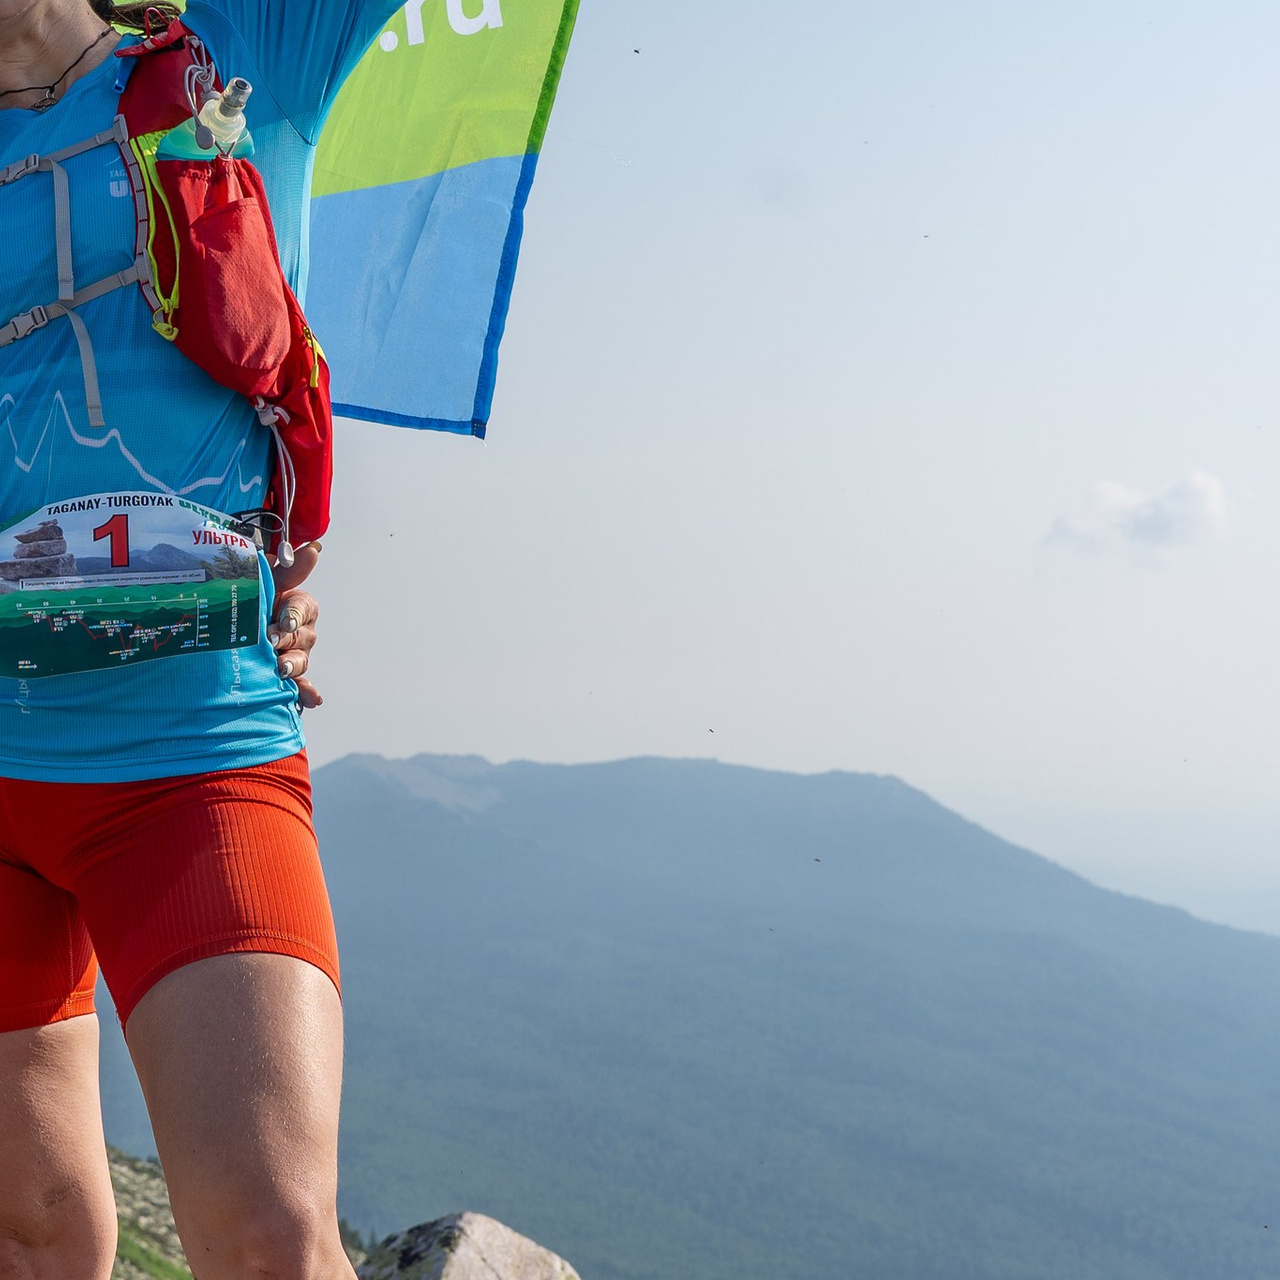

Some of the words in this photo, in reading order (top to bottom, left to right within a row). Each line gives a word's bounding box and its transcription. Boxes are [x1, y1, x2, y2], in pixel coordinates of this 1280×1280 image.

[46, 496, 173, 516] TAGANAY-TURGOYAK
[93, 513, 130, 568] 1
[192, 530, 248, 548] УЛЬТРА
